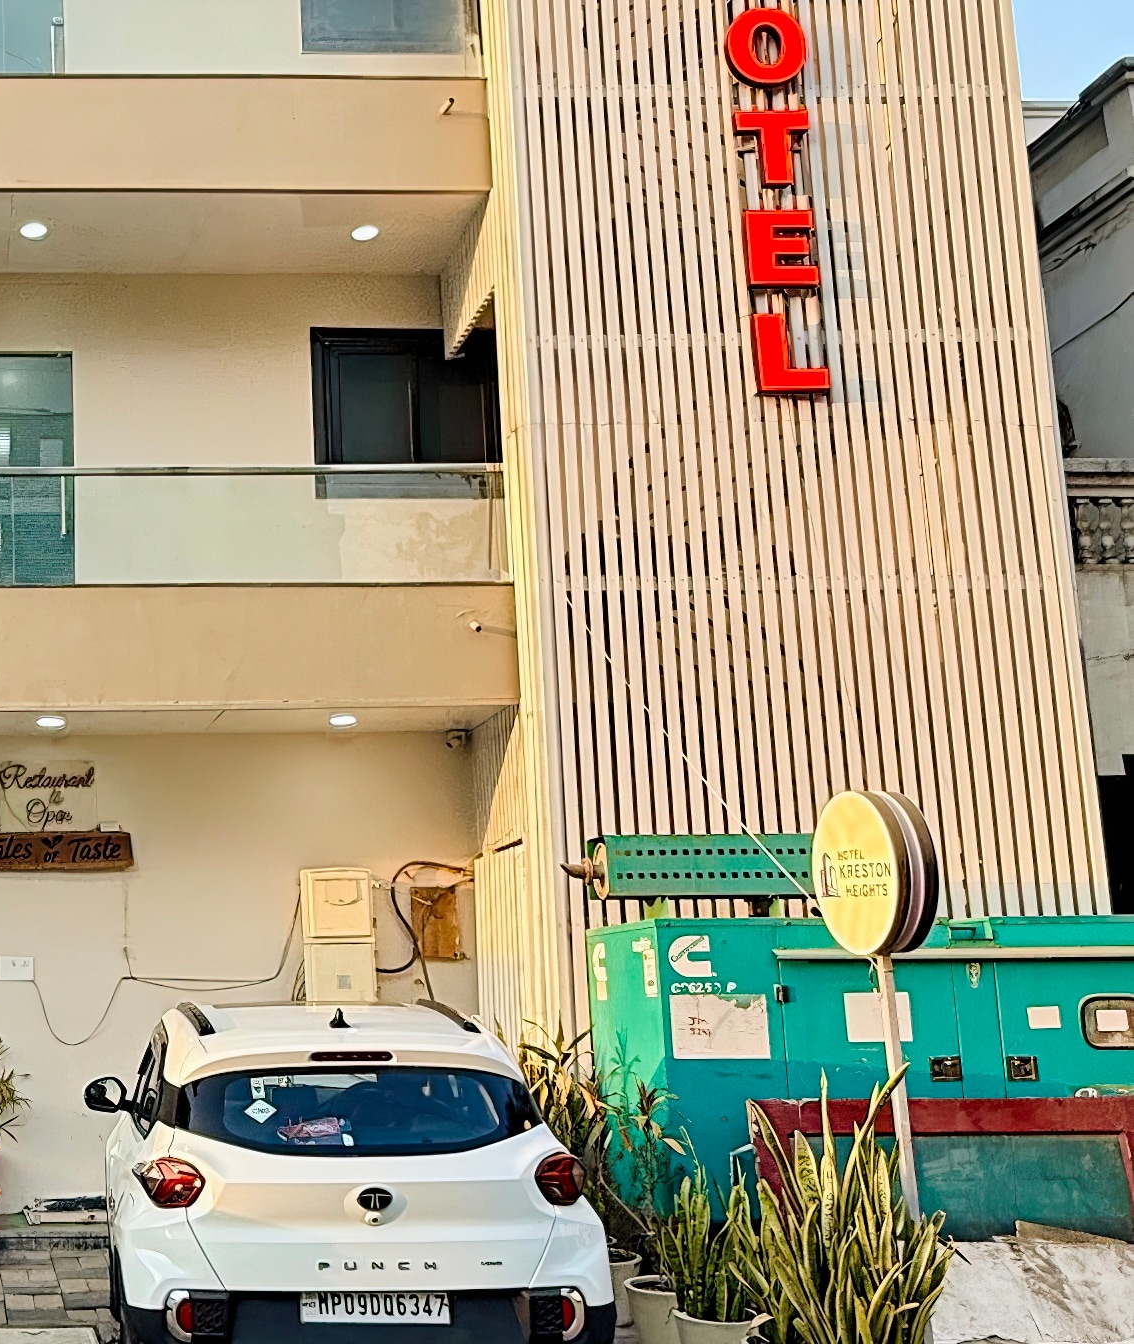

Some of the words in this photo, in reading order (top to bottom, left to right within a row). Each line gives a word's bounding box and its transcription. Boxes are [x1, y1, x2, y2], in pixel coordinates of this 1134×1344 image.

[0, 764, 95, 789] Restaurant
[67, 835, 121, 863] Taste
[837, 849, 865, 860] HOTEL
[839, 862, 891, 879] KRESTON
[846, 883, 888, 897] HEIGHTS
[318, 1261, 437, 1271] PUNCH
